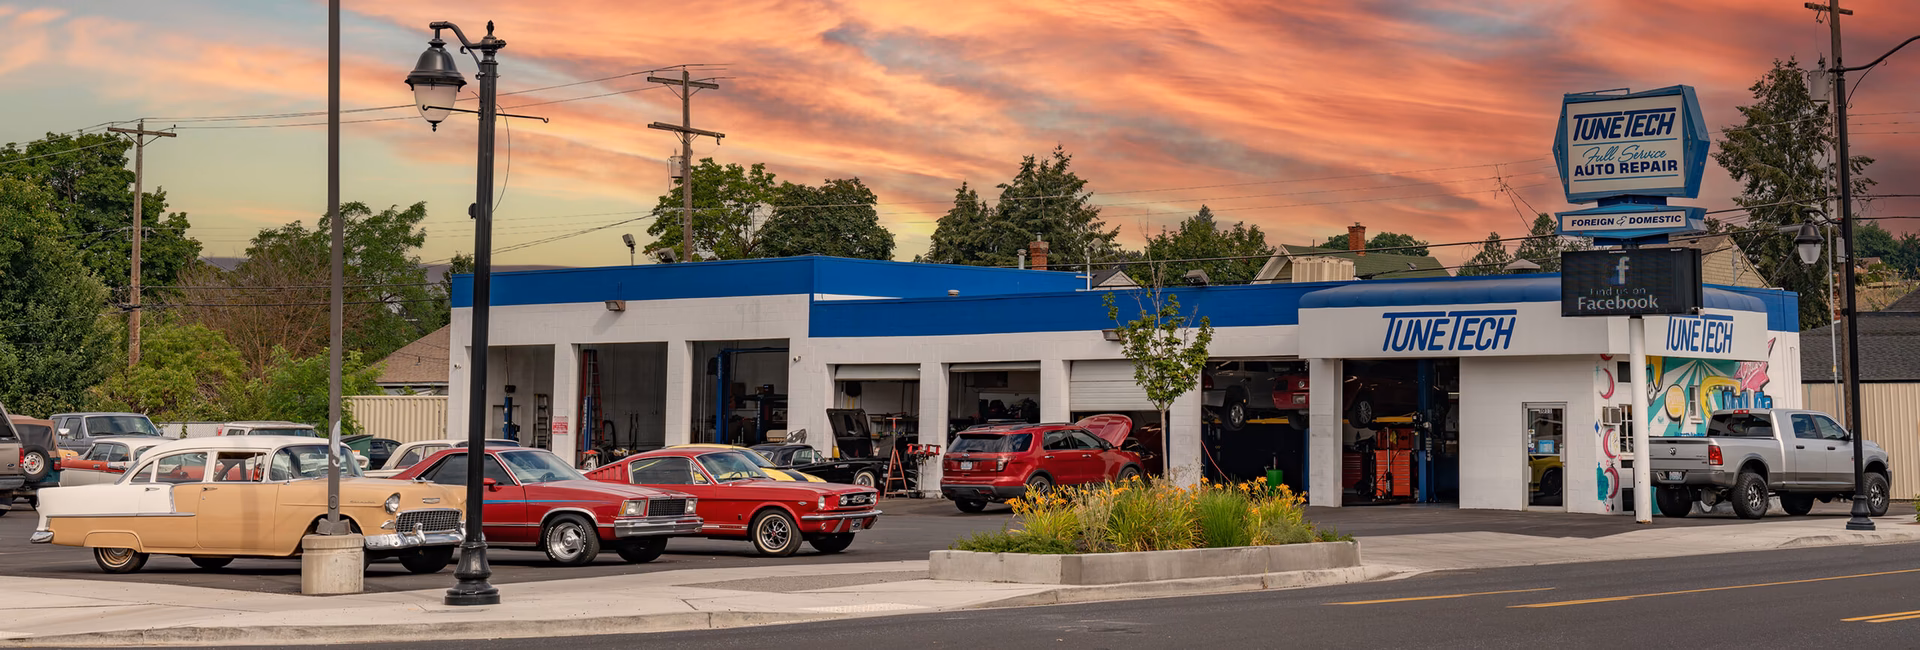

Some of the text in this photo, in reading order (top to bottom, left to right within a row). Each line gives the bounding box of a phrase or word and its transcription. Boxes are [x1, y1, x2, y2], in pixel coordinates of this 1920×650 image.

[1573, 107, 1677, 141] TUNETECH
[1583, 144, 1667, 166] Full Service
[1574, 160, 1678, 177] AUTO REPAIR
[1571, 218, 1615, 227] FOREIGN
[1629, 215, 1682, 225] DOMESTIC
[1578, 294, 1659, 310] Facebook
[1382, 309, 1517, 352] TUNETECH
[1666, 314, 1734, 354] TUNETECH
